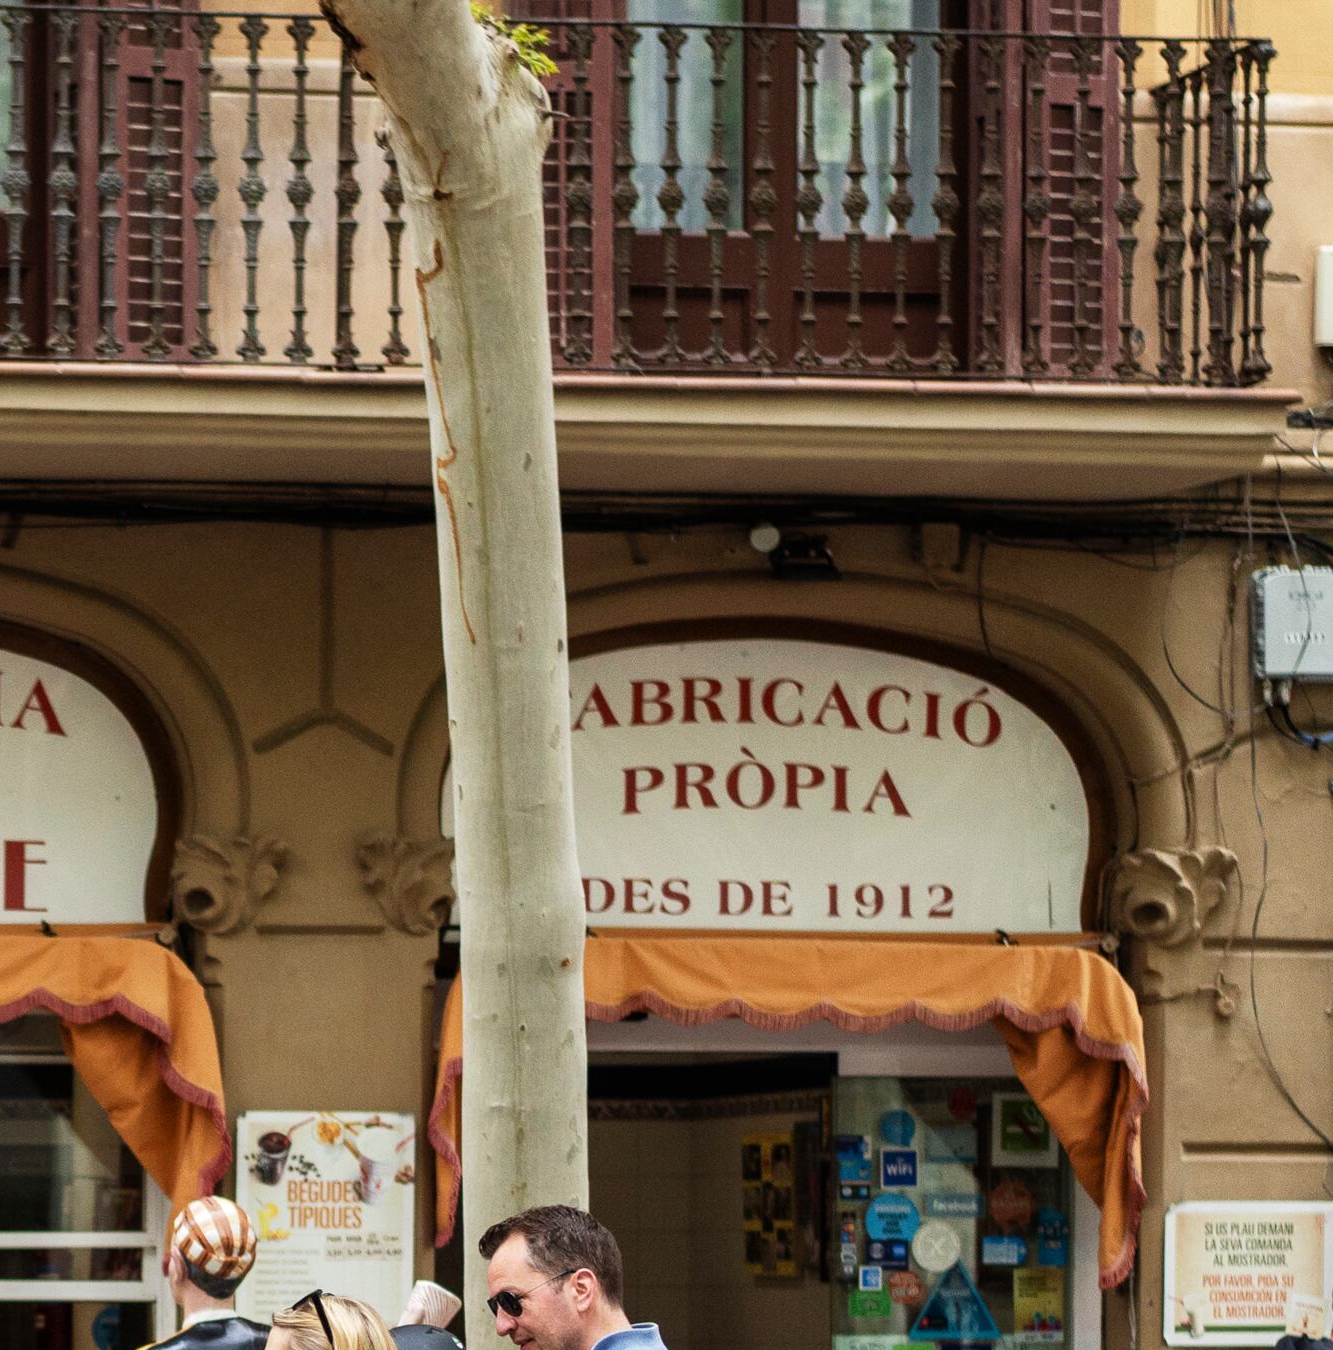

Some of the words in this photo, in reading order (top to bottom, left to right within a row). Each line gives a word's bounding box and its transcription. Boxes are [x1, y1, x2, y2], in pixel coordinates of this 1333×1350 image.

[571, 676, 1003, 748] ABRICACIÓ
[621, 745, 913, 818] PRÒPIA
[583, 876, 692, 917] DES
[717, 880, 794, 918] DE
[827, 882, 955, 920] 1912
[287, 1179, 362, 1203] BEGUDES
[1204, 1222, 1213, 1236] SI
[1215, 1222, 1227, 1236] US
[1230, 1222, 1255, 1236] PLAU
[1257, 1222, 1294, 1236] DEMANI
[1204, 1239, 1217, 1251] LA
[1219, 1239, 1242, 1251] SEVA
[1245, 1238, 1293, 1251] COMANDA
[1213, 1254, 1224, 1267] AL
[1203, 1274, 1221, 1289] POR
[1257, 1274, 1278, 1289] PIDA
[1282, 1274, 1294, 1289] SU
[1275, 1290, 1287, 1303] EN
[1213, 1306, 1222, 1319] EL
